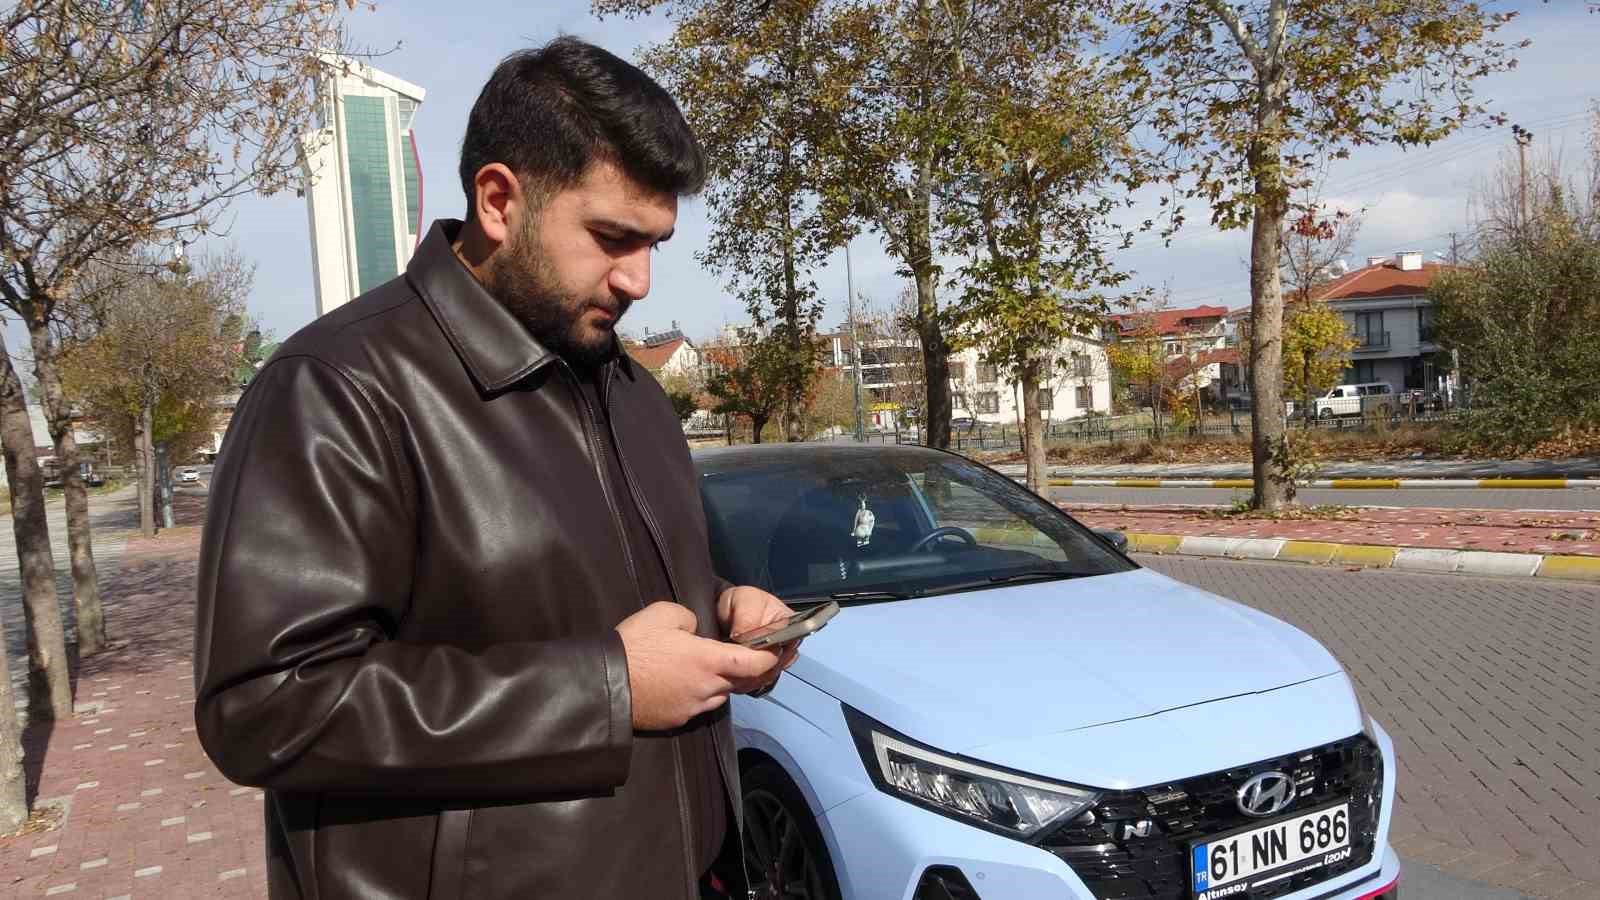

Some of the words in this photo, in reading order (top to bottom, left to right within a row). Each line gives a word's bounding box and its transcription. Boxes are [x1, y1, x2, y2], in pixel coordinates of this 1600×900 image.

[1210, 840, 1239, 881] 61
[1252, 826, 1287, 870] NN
[1299, 809, 1347, 854] 686
[1195, 871, 1207, 884] TR
